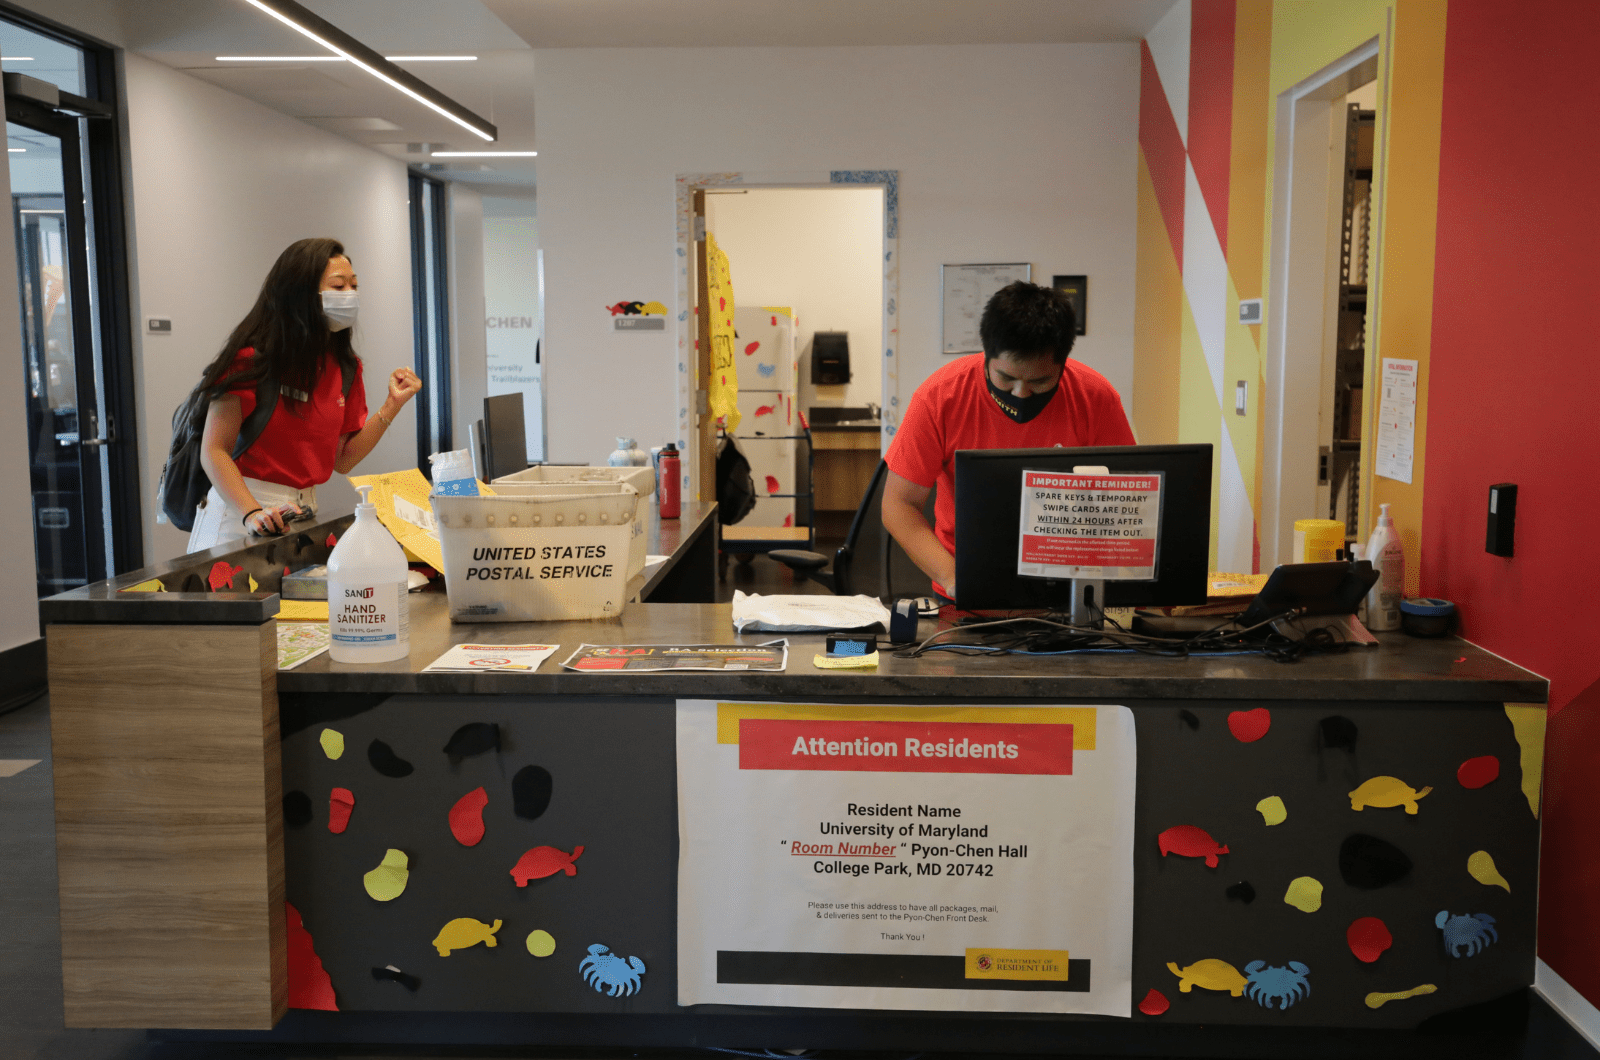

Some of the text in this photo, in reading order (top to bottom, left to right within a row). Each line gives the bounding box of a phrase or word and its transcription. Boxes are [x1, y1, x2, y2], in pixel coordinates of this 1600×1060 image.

[486, 316, 532, 329] CHEN
[1033, 478, 1151, 489] IMPORTANT REMINDER!
[1036, 492, 1061, 500] SPARE
[1043, 504, 1069, 512] SWIPE
[1038, 515, 1069, 524] WITHIN
[1034, 526, 1078, 535] CHECKING
[473, 545, 606, 560] UNITED STATES
[466, 565, 613, 580] POSTAL SERVICE
[344, 604, 376, 613] HAND
[338, 614, 386, 624] SANITIZER
[792, 736, 1019, 759] Attention Residents
[847, 804, 961, 818] Resident Name
[820, 822, 988, 839] University of Maryland
[790, 841, 834, 854] Room
[837, 842, 896, 856] Number
[911, 844, 993, 858] Pyon-Chen
[999, 846, 1028, 858] Hall
[813, 861, 994, 878] College Park, MD 20742
[808, 901, 834, 910] Please
[851, 902, 865, 911] this
[867, 903, 897, 911] address
[909, 903, 928, 911] have
[928, 904, 938, 912] all
[940, 904, 978, 914] packages,
[980, 905, 998, 914] mail,
[824, 912, 859, 920] deliveries
[889, 913, 902, 921] the
[904, 914, 944, 923] Pyon-Chen
[968, 915, 990, 923] Desk.
[881, 932, 904, 941] Thank
